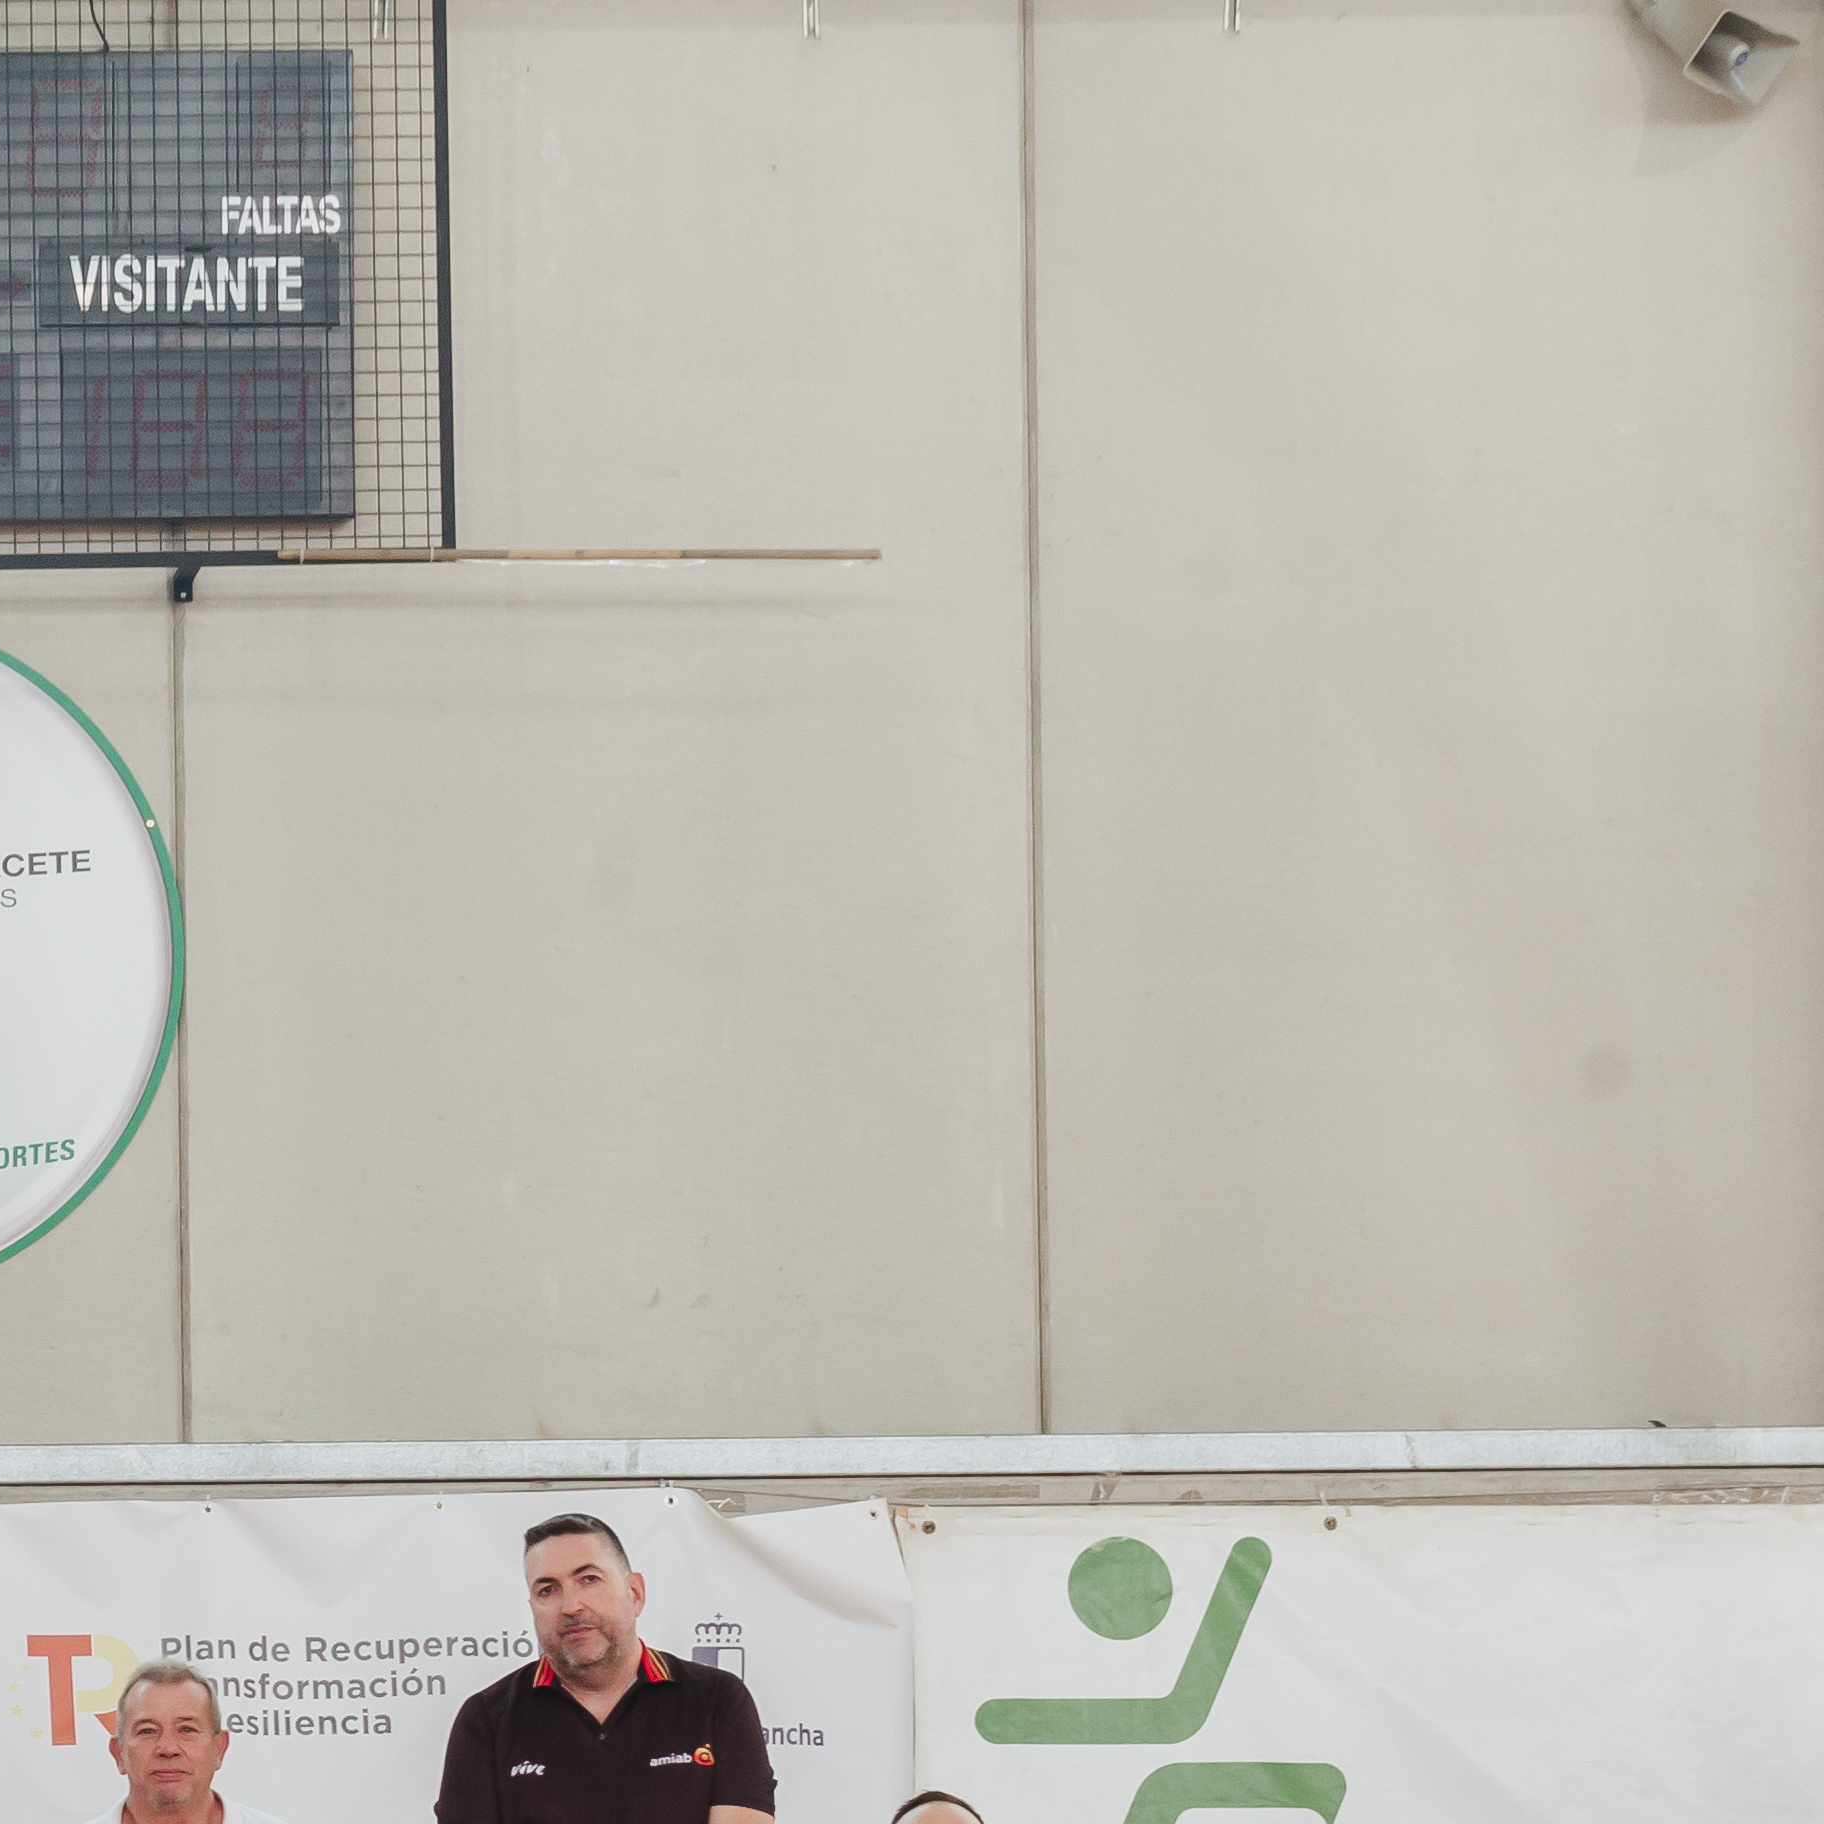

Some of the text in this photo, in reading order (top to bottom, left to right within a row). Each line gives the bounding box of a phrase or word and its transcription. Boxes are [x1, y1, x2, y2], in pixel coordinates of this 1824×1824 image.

[221, 194, 342, 236] FALTAS
[70, 254, 305, 313] VISITANTE
[160, 1630, 541, 1665] Plan de Recuperació
[209, 1668, 447, 1701] nsformación
[226, 1708, 393, 1737] esiliencia
[762, 1722, 825, 1747] ancha
[649, 1752, 693, 1768] amiab
